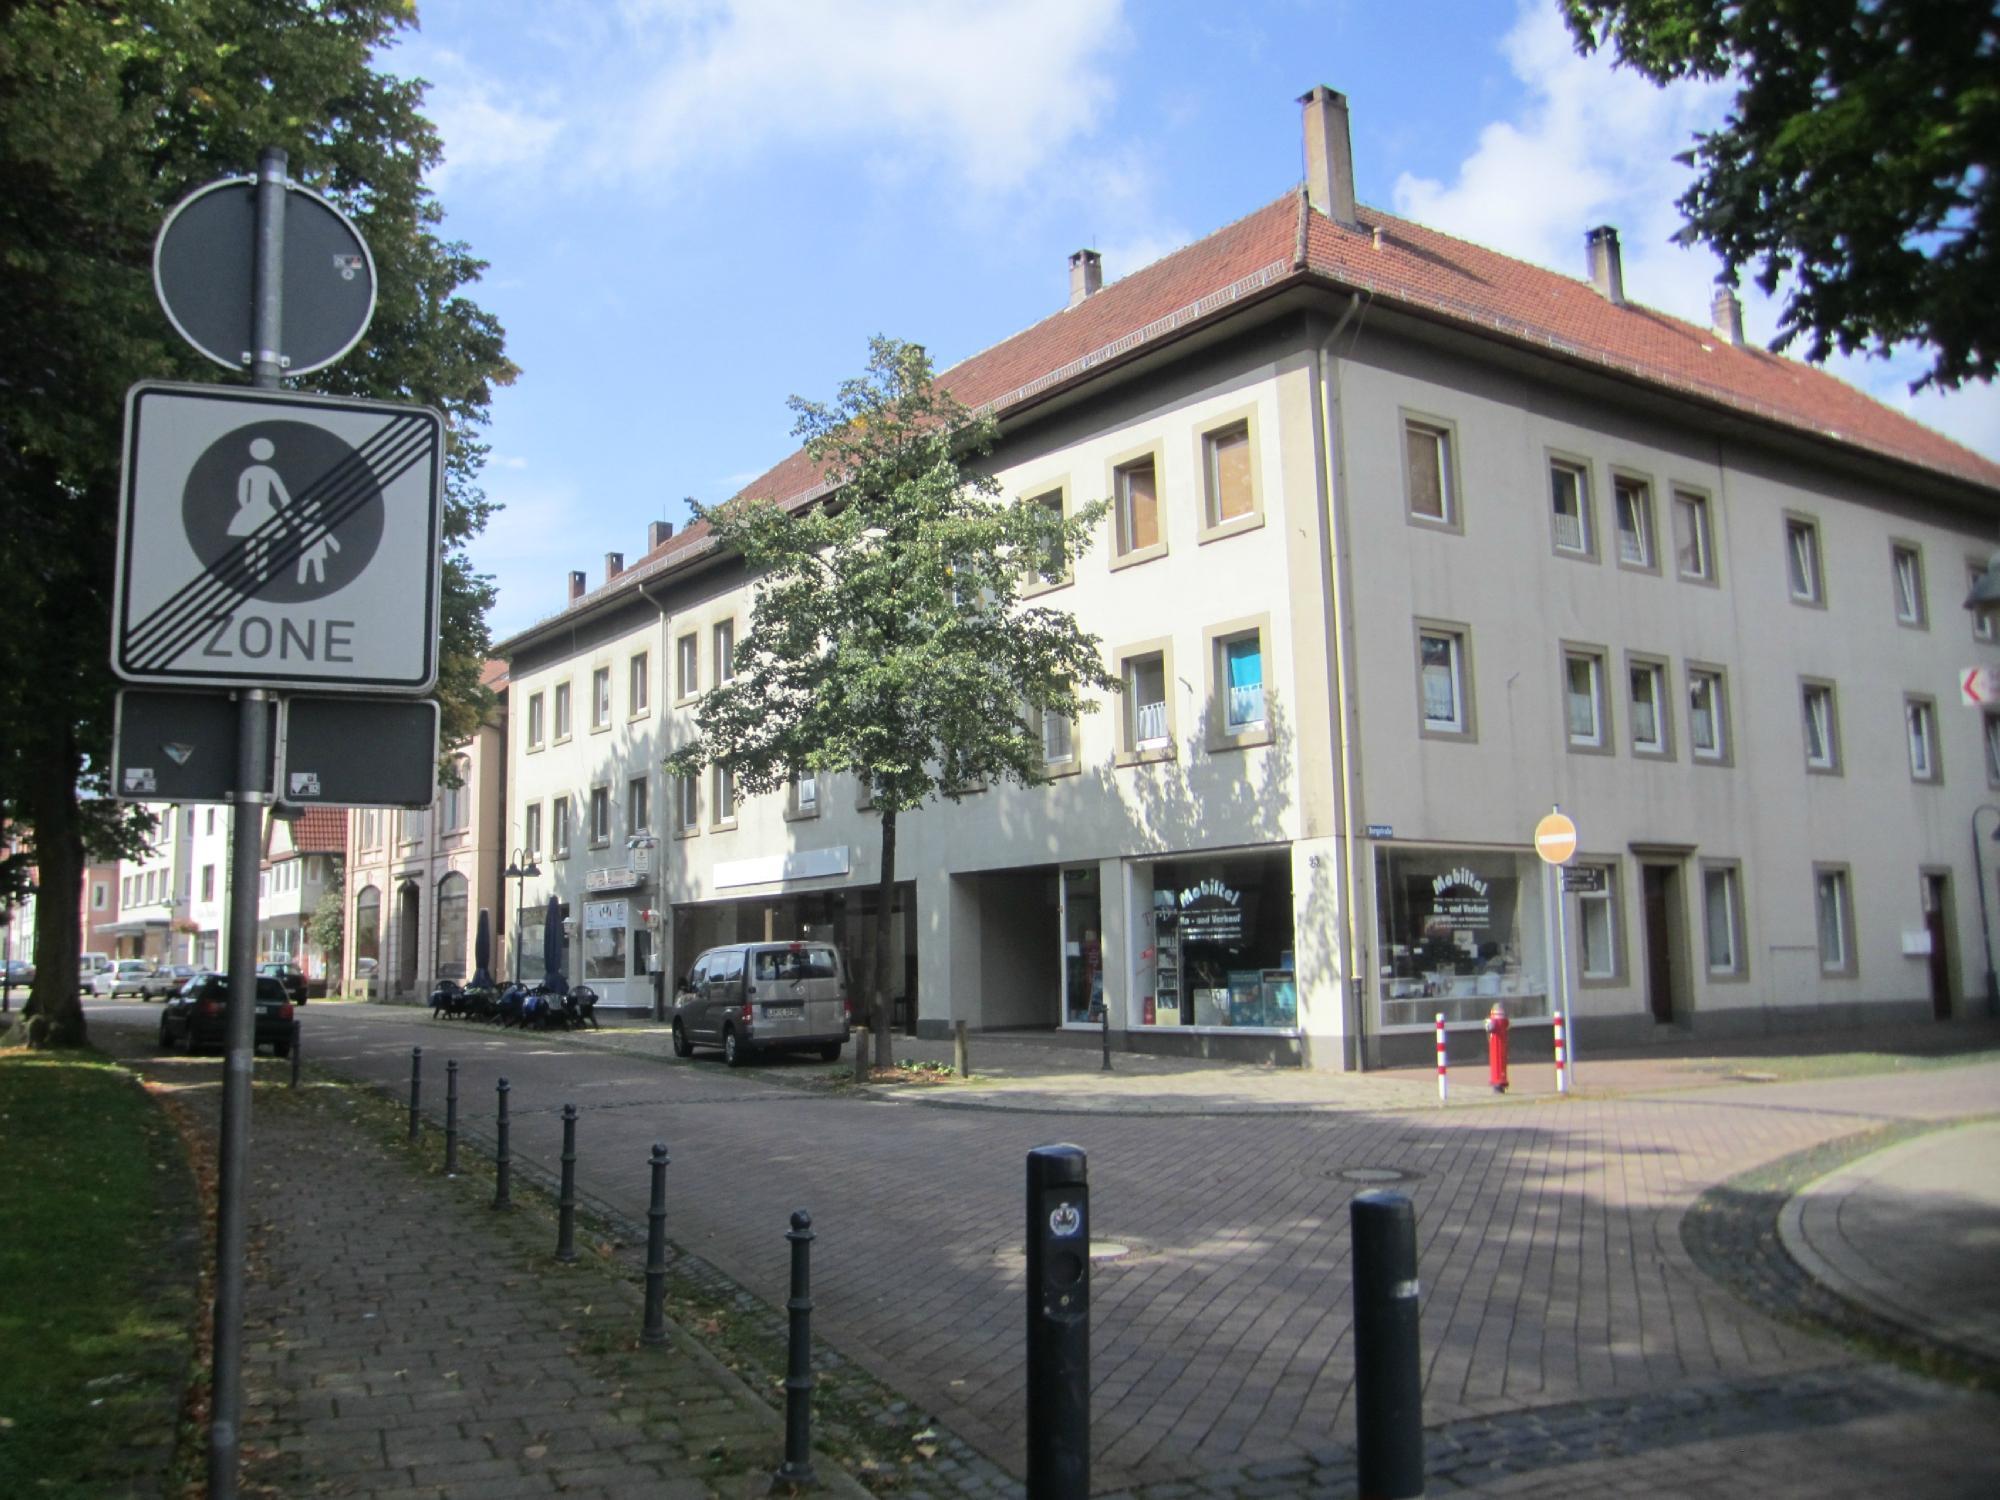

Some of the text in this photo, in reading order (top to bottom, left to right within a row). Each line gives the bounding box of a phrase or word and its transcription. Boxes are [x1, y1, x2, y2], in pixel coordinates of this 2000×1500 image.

[203, 615, 355, 662] ZONE
[1179, 878, 1240, 908] Mobiltel
[1431, 867, 1488, 896] Mobiltel
